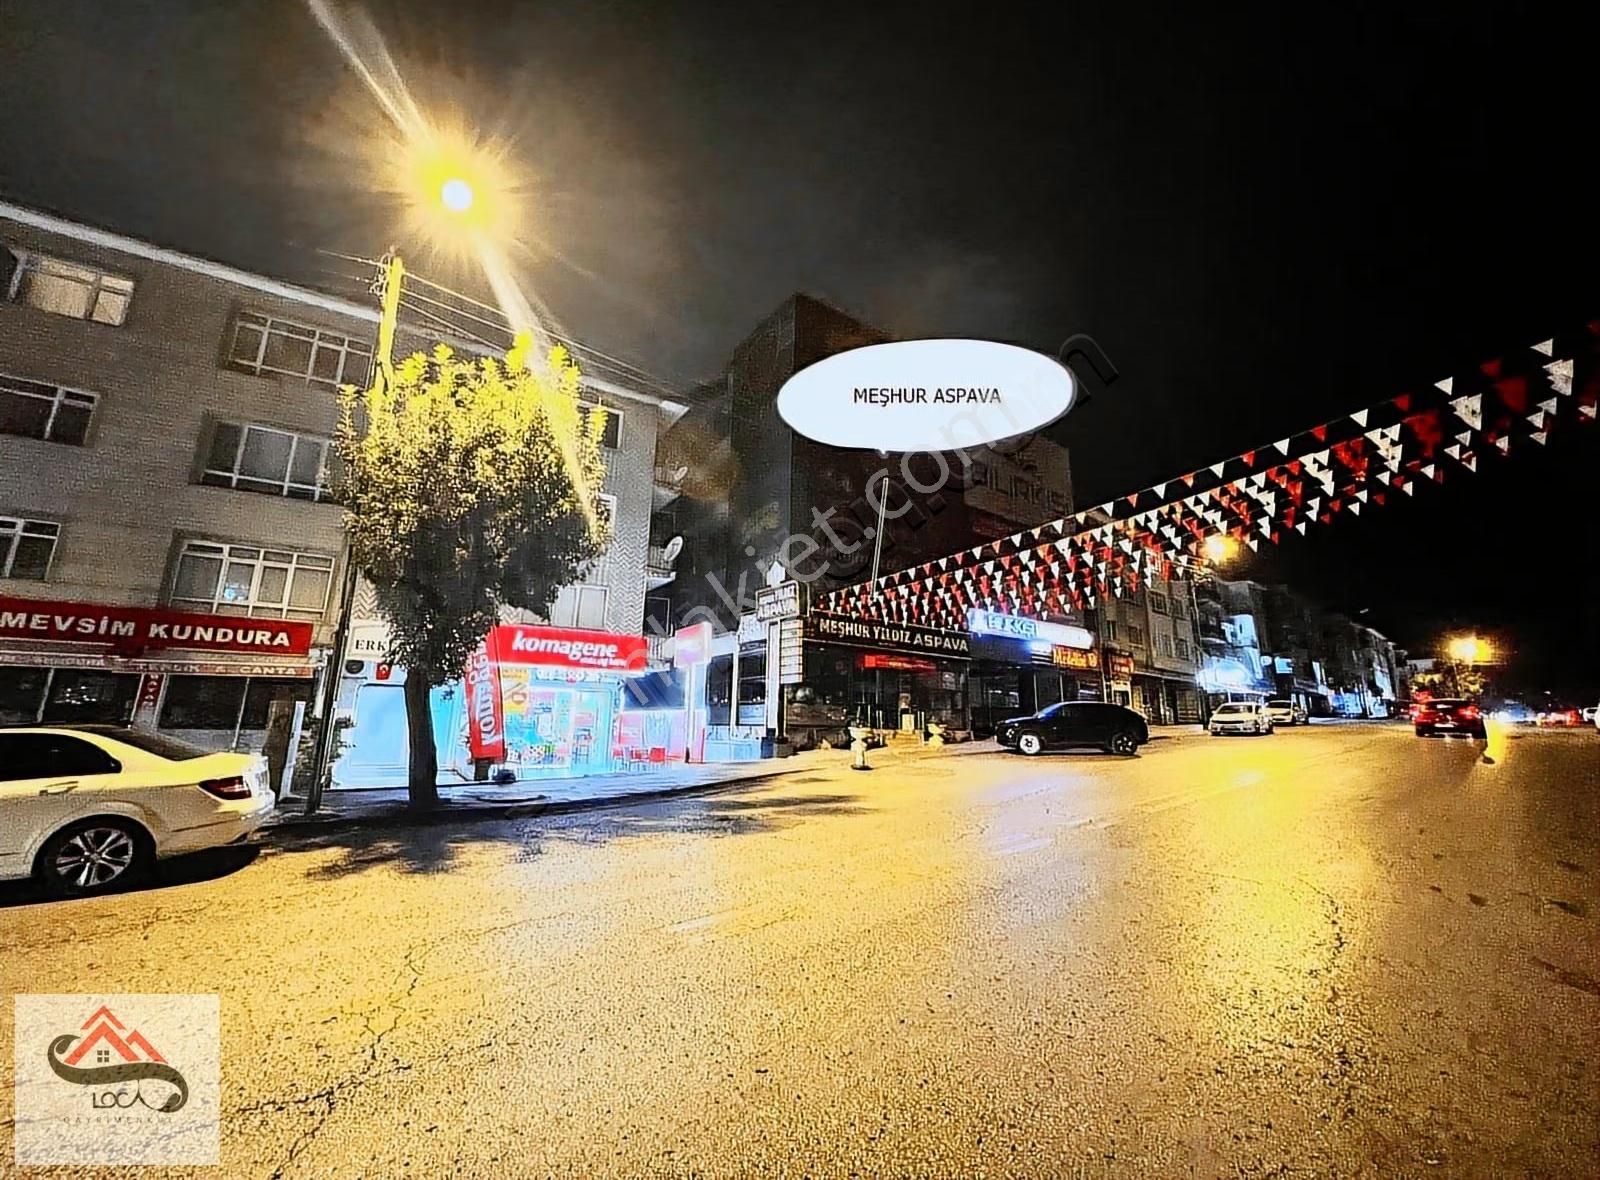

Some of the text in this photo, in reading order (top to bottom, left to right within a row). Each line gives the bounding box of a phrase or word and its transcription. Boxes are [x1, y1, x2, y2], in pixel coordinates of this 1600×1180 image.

[0, 610, 291, 648] MEVSİM KUNDURA
[511, 630, 619, 661] komagene
[818, 617, 871, 638] MEŞHUR
[912, 633, 969, 652] ASPAVA
